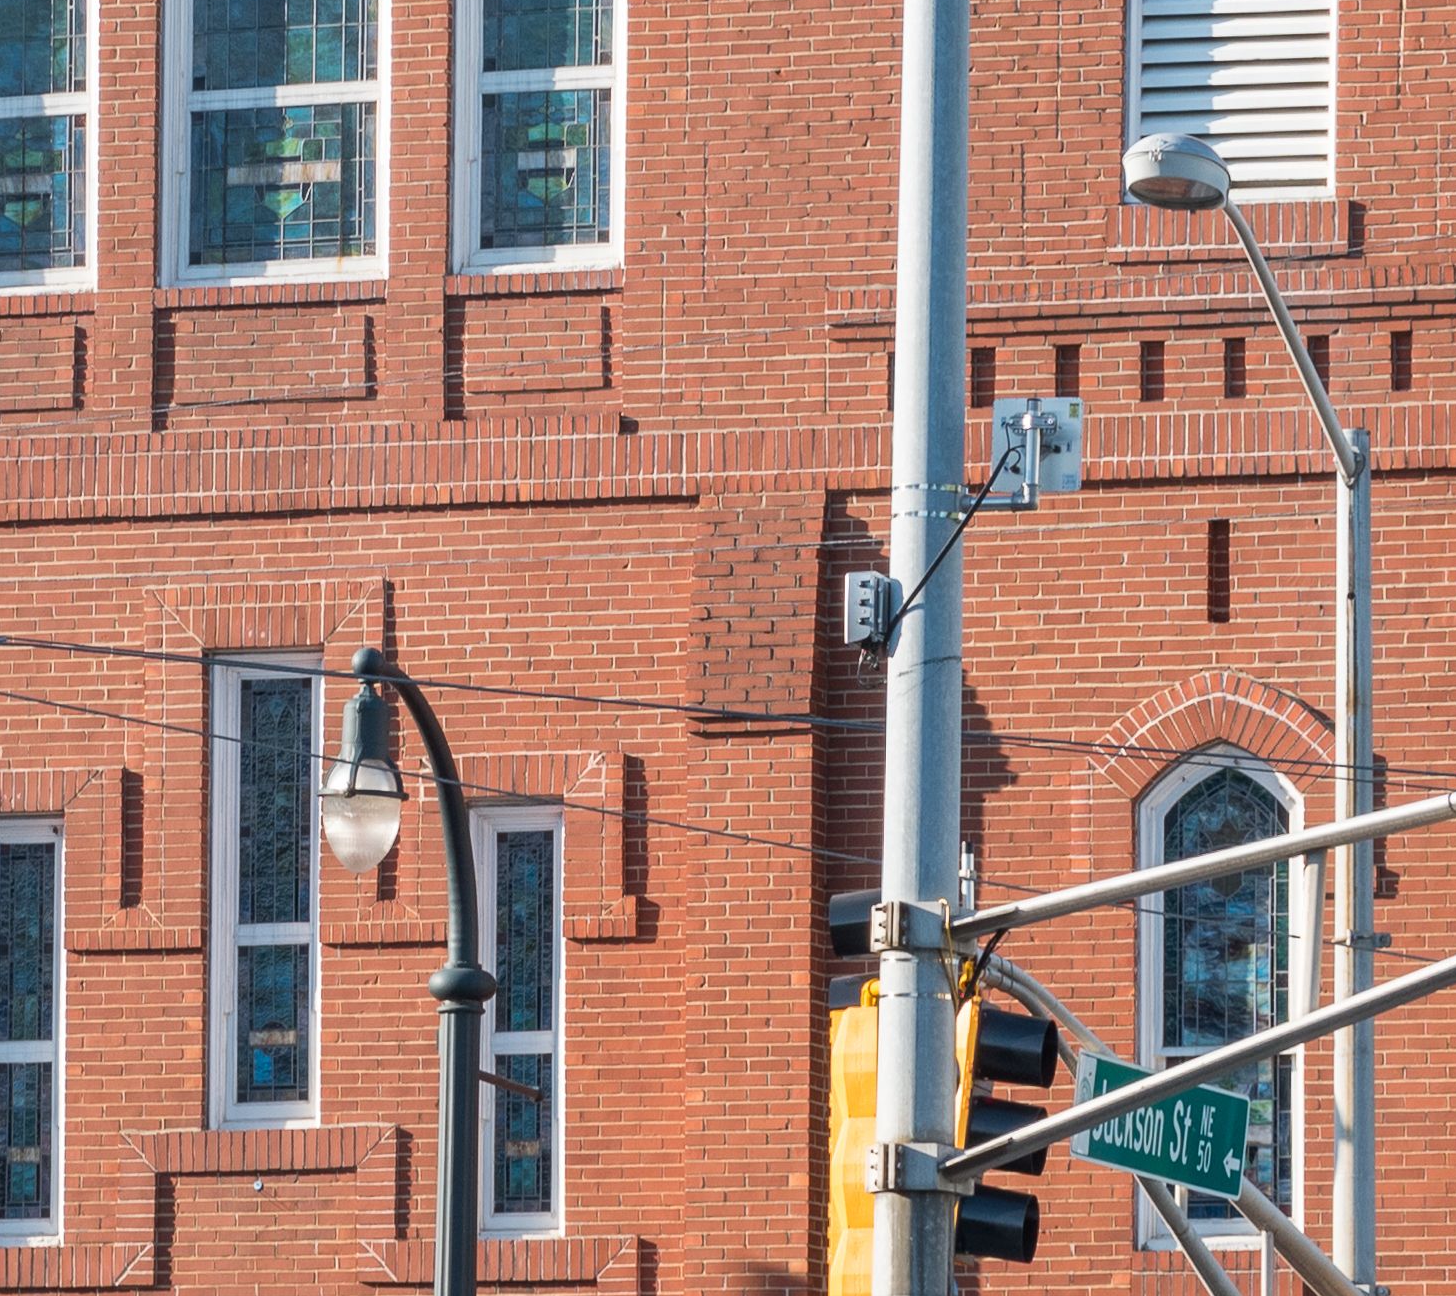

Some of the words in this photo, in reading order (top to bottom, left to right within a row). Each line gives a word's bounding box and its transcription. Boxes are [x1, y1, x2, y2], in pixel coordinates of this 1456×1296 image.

[1169, 1099, 1193, 1166] St
[1199, 1104, 1216, 1139] NE
[1196, 1139, 1212, 1174] 50
